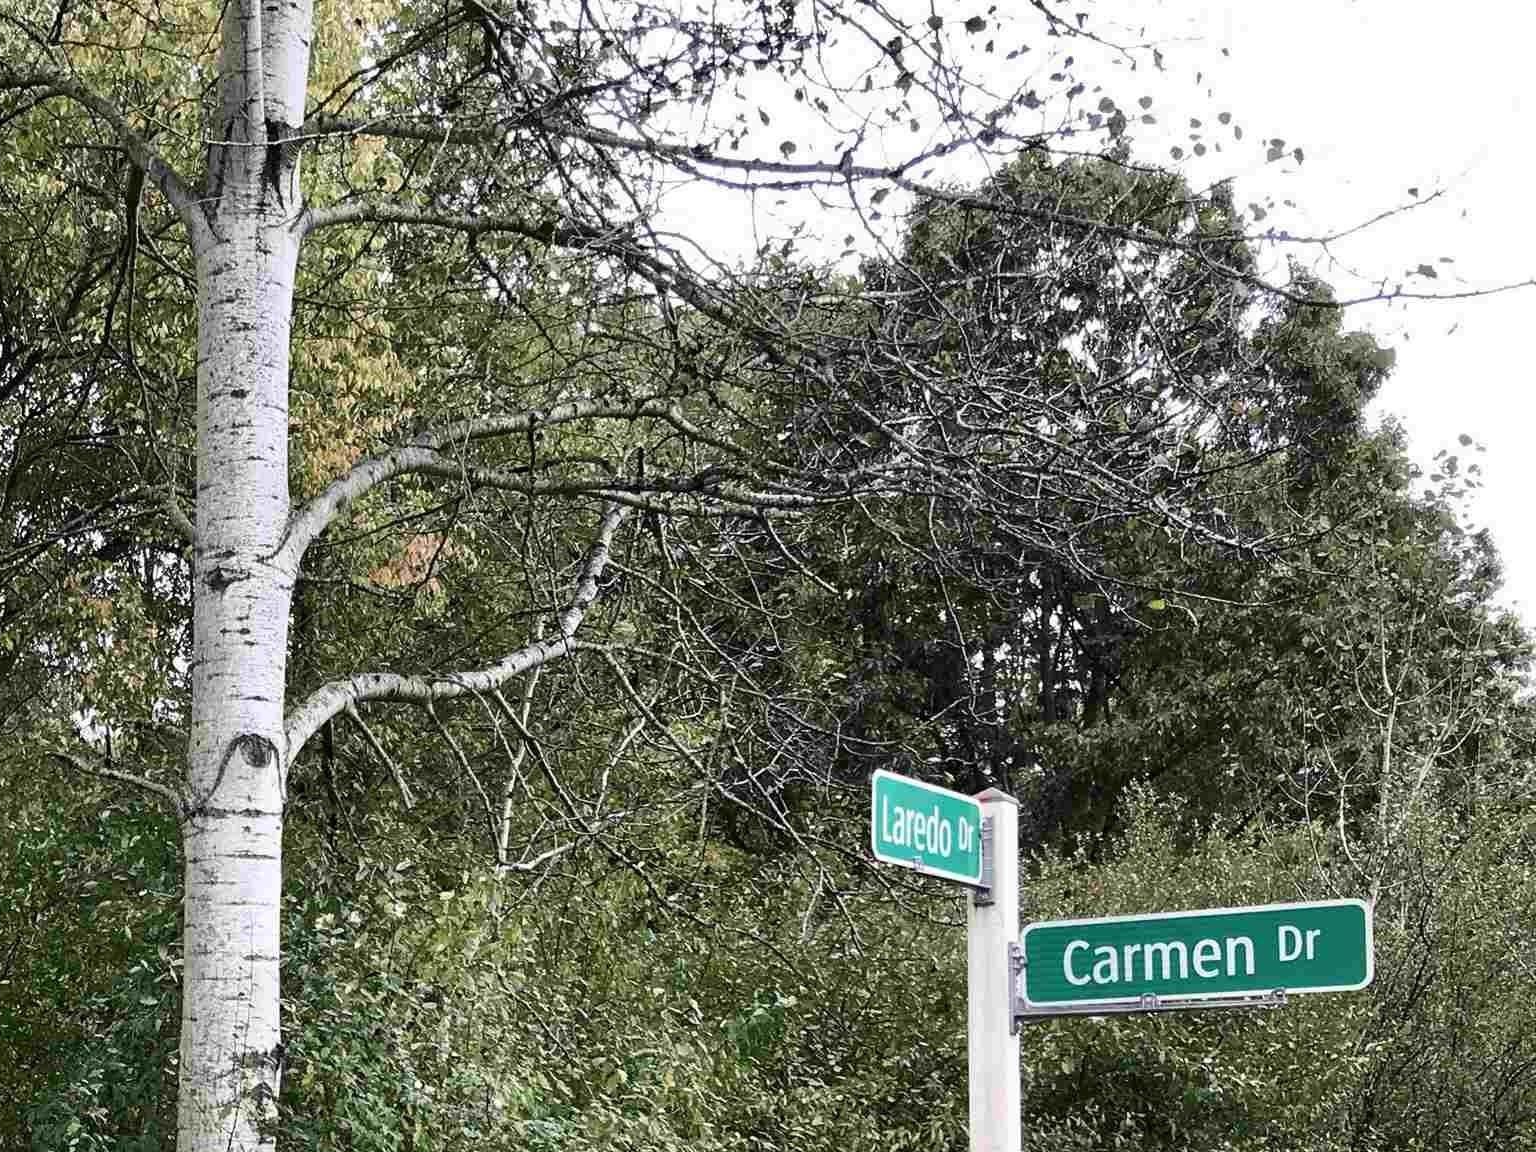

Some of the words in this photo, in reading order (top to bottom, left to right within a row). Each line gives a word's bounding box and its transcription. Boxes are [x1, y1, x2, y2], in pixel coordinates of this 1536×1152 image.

[881, 794, 952, 858] Laredo
[958, 815, 975, 853] Dr
[1063, 936, 1255, 986] Carmen
[1278, 925, 1321, 962] Dr
